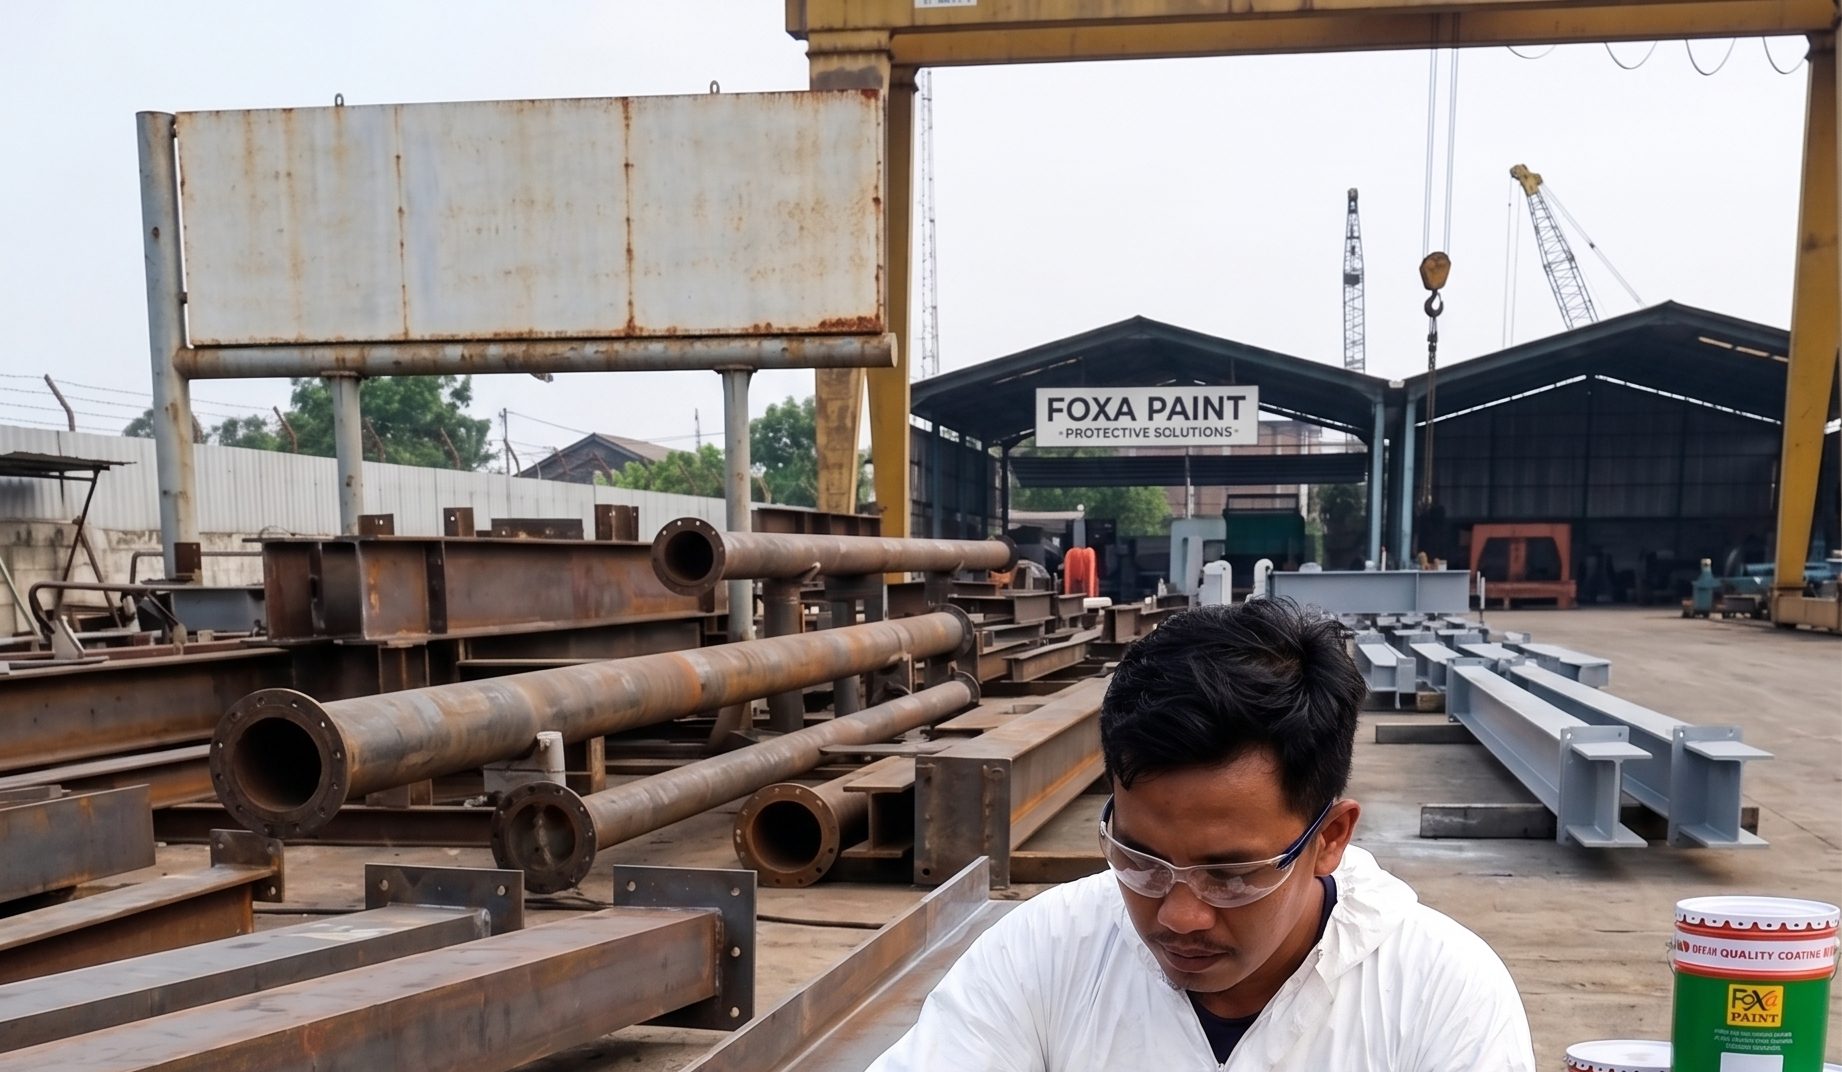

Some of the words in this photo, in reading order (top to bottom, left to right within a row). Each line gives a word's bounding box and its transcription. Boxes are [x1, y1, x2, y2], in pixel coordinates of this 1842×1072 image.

[1047, 396, 1137, 422] FOXA
[1148, 395, 1246, 421] PAINT
[1065, 427, 1150, 439] PROTECTIVE
[1154, 426, 1232, 438] SOLUTIONS
[1720, 948, 1774, 960] QUALITY
[1731, 1012, 1779, 1023] PAINT
